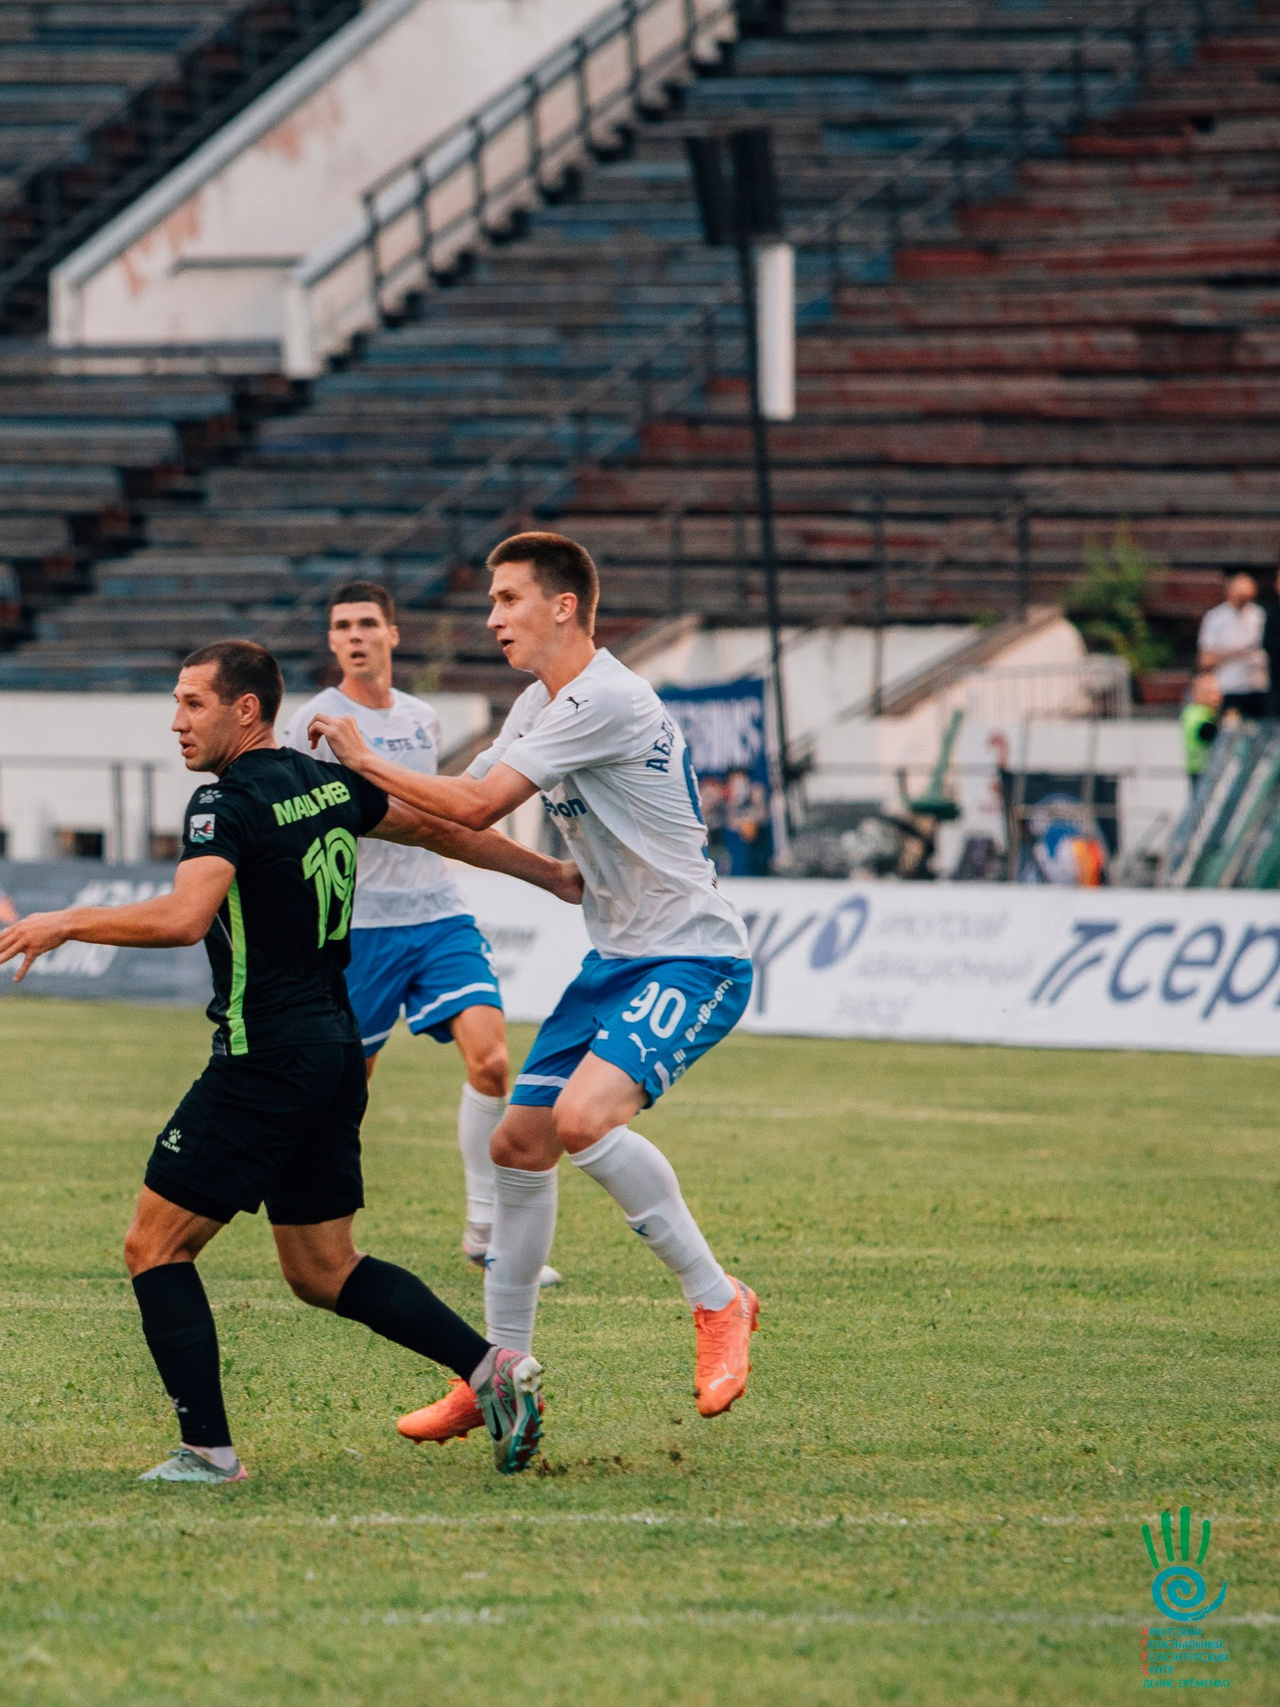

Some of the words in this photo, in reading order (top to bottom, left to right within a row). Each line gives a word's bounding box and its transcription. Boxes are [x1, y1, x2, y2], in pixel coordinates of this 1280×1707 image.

[302, 827, 357, 949] 19
[621, 981, 687, 1039] 90
[684, 978, 734, 1043] BetBoom
